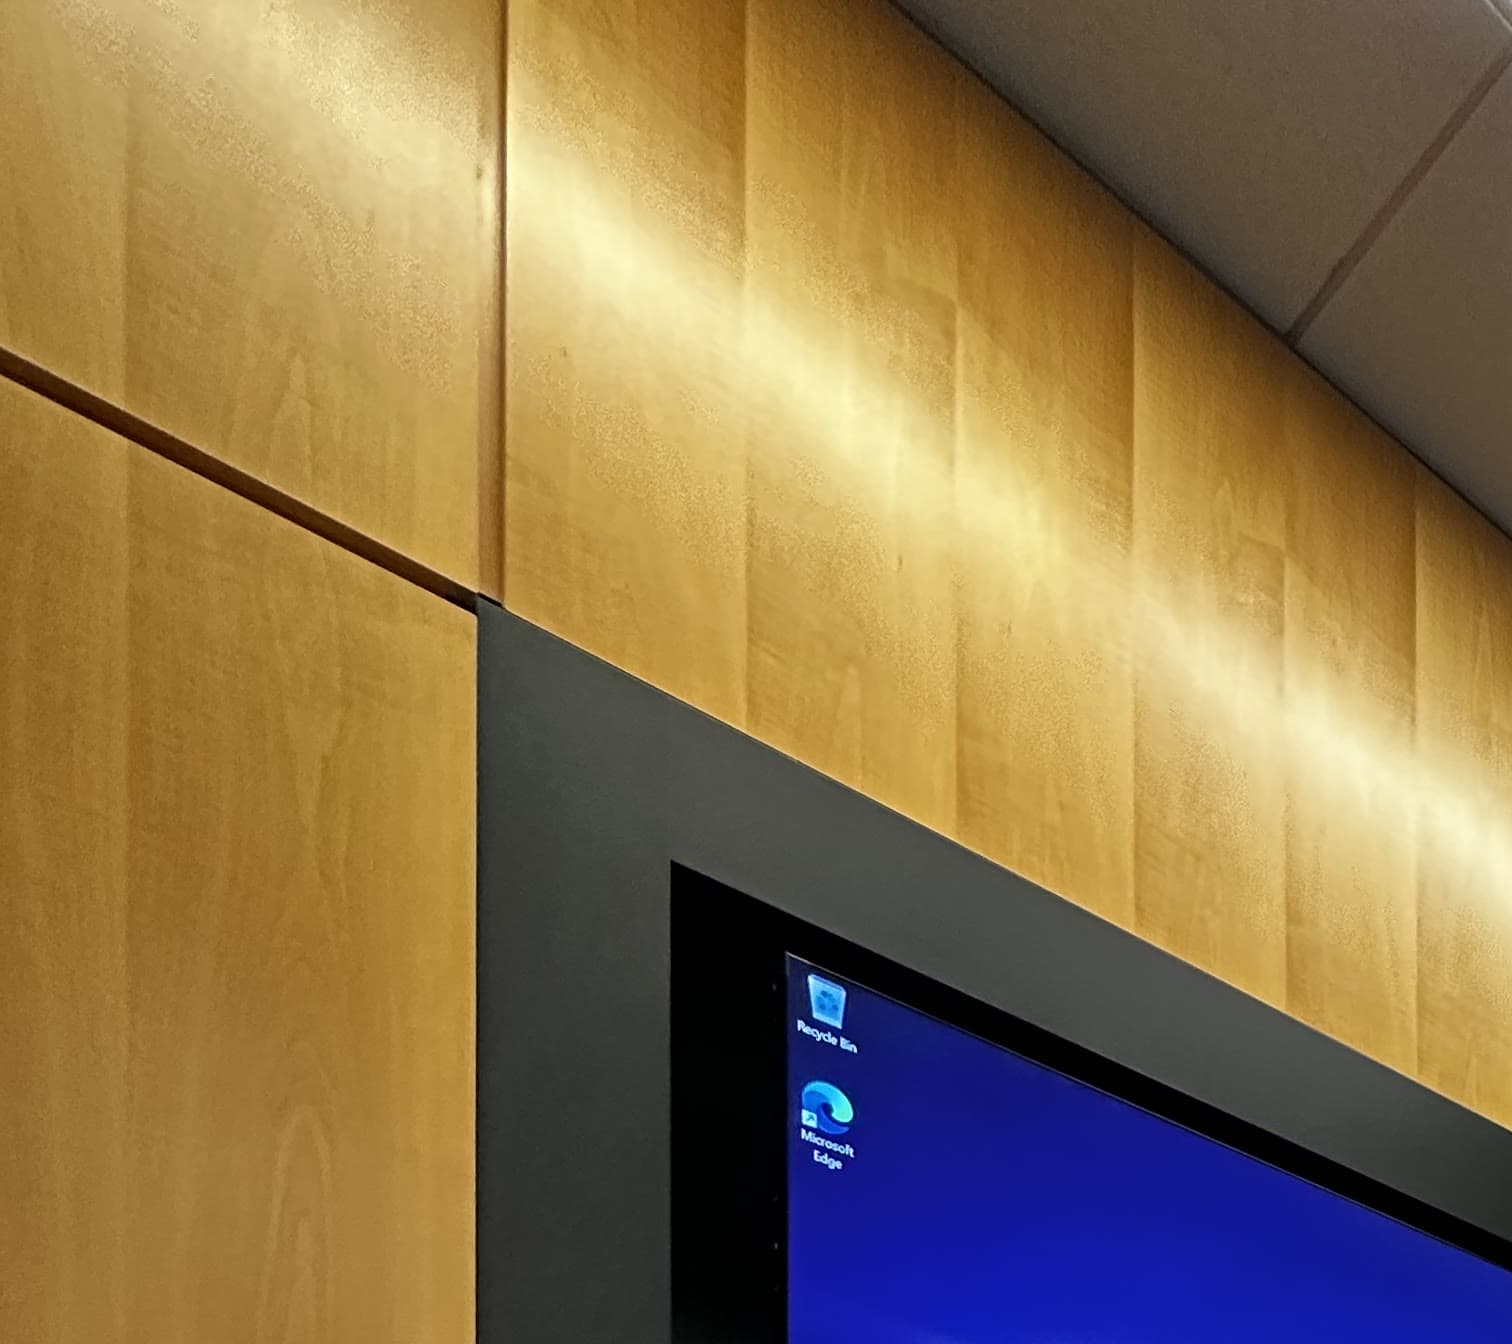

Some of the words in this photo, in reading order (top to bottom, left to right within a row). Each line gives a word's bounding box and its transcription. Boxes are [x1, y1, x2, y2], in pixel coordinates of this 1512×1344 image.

[797, 1019, 838, 1046] Recycle
[840, 1036, 858, 1053] Bin
[801, 1128, 855, 1158] Microsoft
[813, 1149, 843, 1170] Edge
